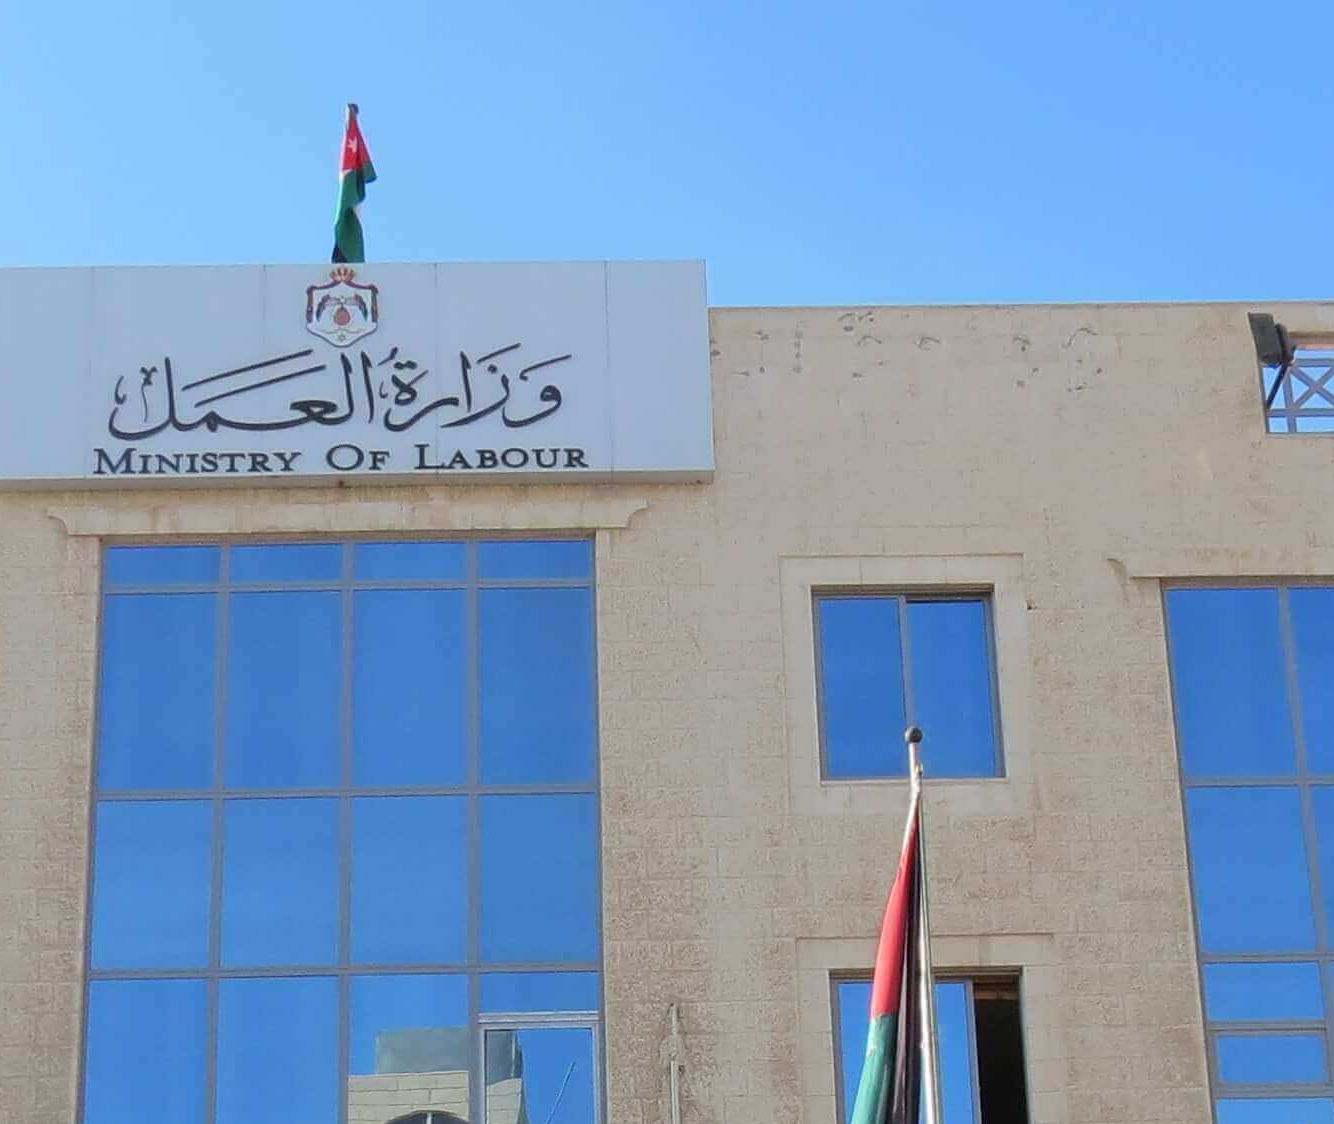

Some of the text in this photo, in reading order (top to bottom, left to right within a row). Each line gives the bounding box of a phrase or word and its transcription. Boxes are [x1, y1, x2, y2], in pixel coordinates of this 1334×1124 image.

[92, 443, 590, 475] MINISTRY OF LABOUR
